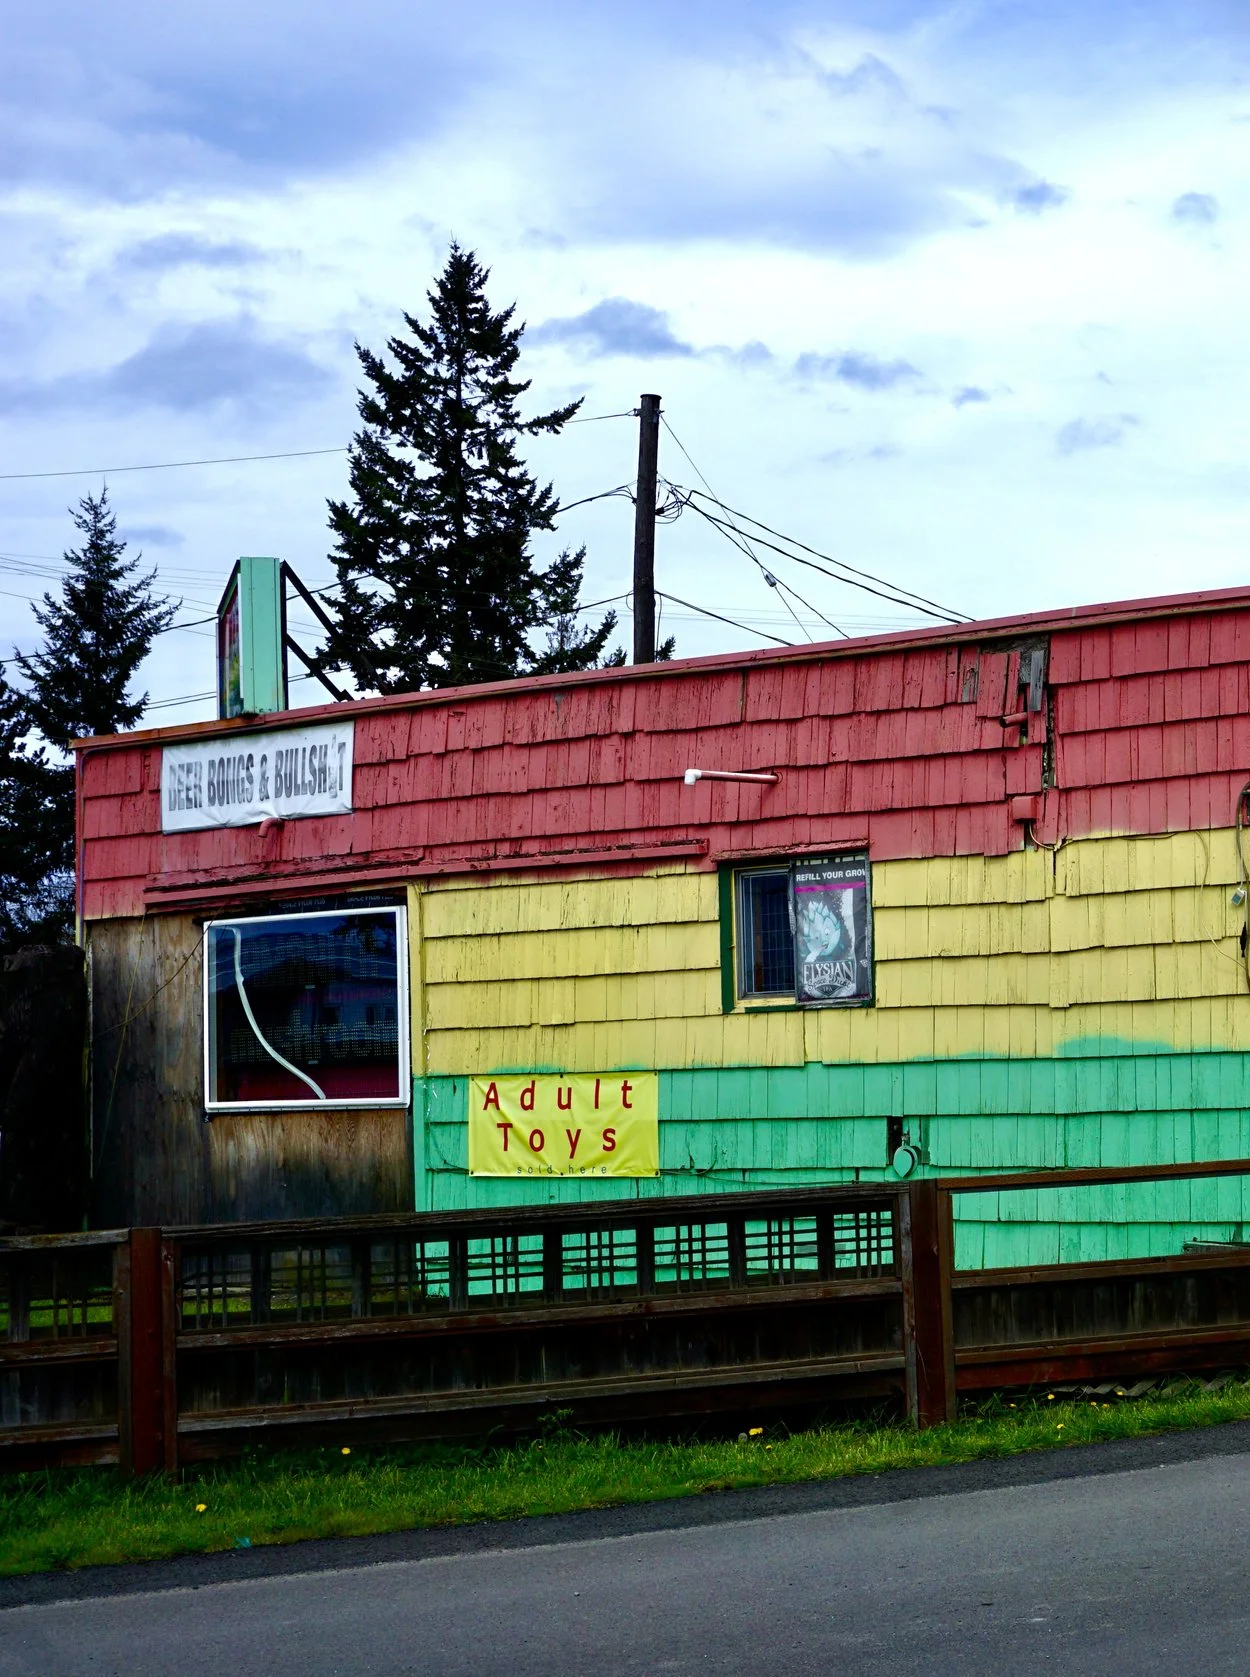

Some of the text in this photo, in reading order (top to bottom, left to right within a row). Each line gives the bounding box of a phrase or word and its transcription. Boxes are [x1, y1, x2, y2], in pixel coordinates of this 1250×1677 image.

[208, 753, 255, 807] BONGS
[259, 753, 270, 802] &
[795, 872, 821, 882] REFILL
[822, 870, 844, 880] YOUR
[803, 961, 854, 985] ELYSIAN
[482, 1078, 633, 1111] Adult
[496, 1122, 617, 1159] Toys
[516, 1164, 607, 1175] sold here
